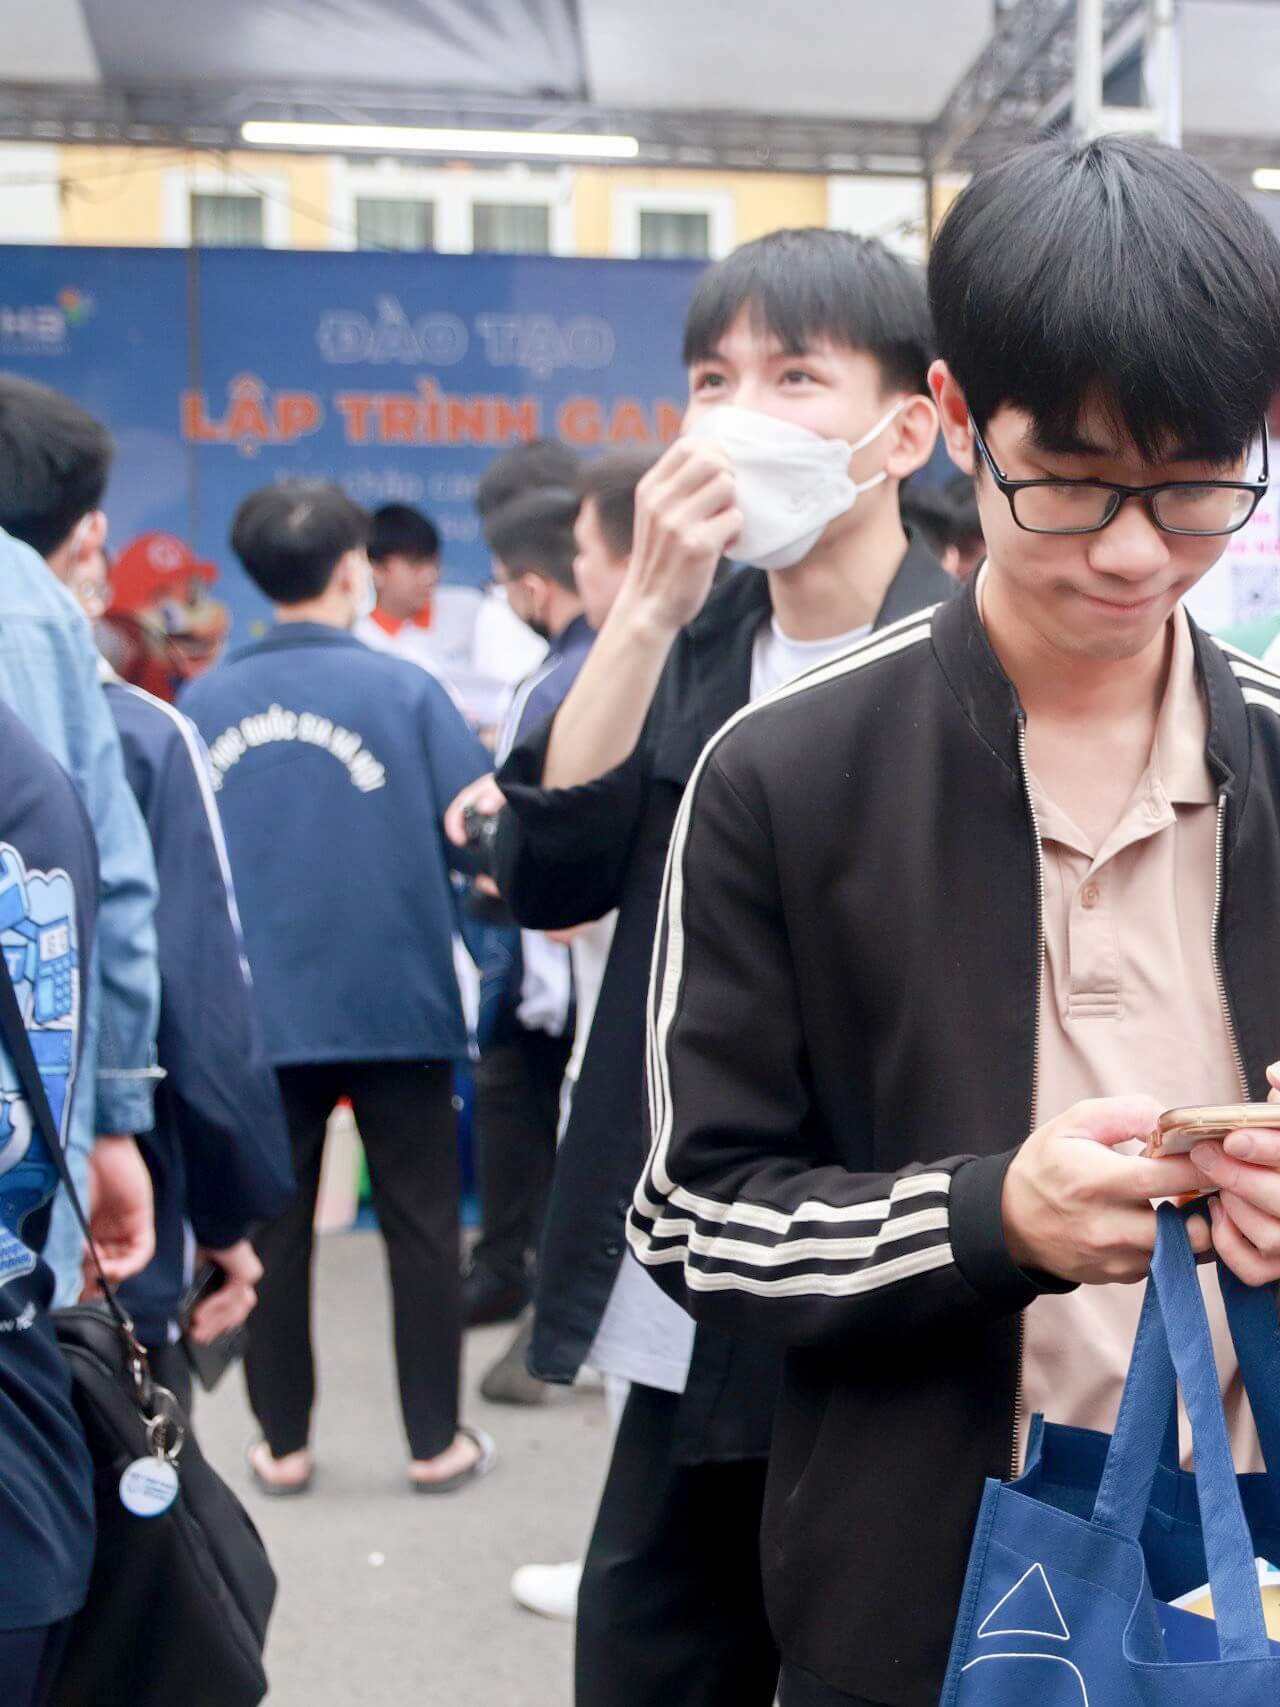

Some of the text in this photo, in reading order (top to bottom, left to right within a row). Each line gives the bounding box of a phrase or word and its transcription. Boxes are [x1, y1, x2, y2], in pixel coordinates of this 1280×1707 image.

[316, 295, 614, 381] ĐÀO TẠO
[179, 372, 320, 457] LẬP
[335, 375, 540, 445] TRÌNH
